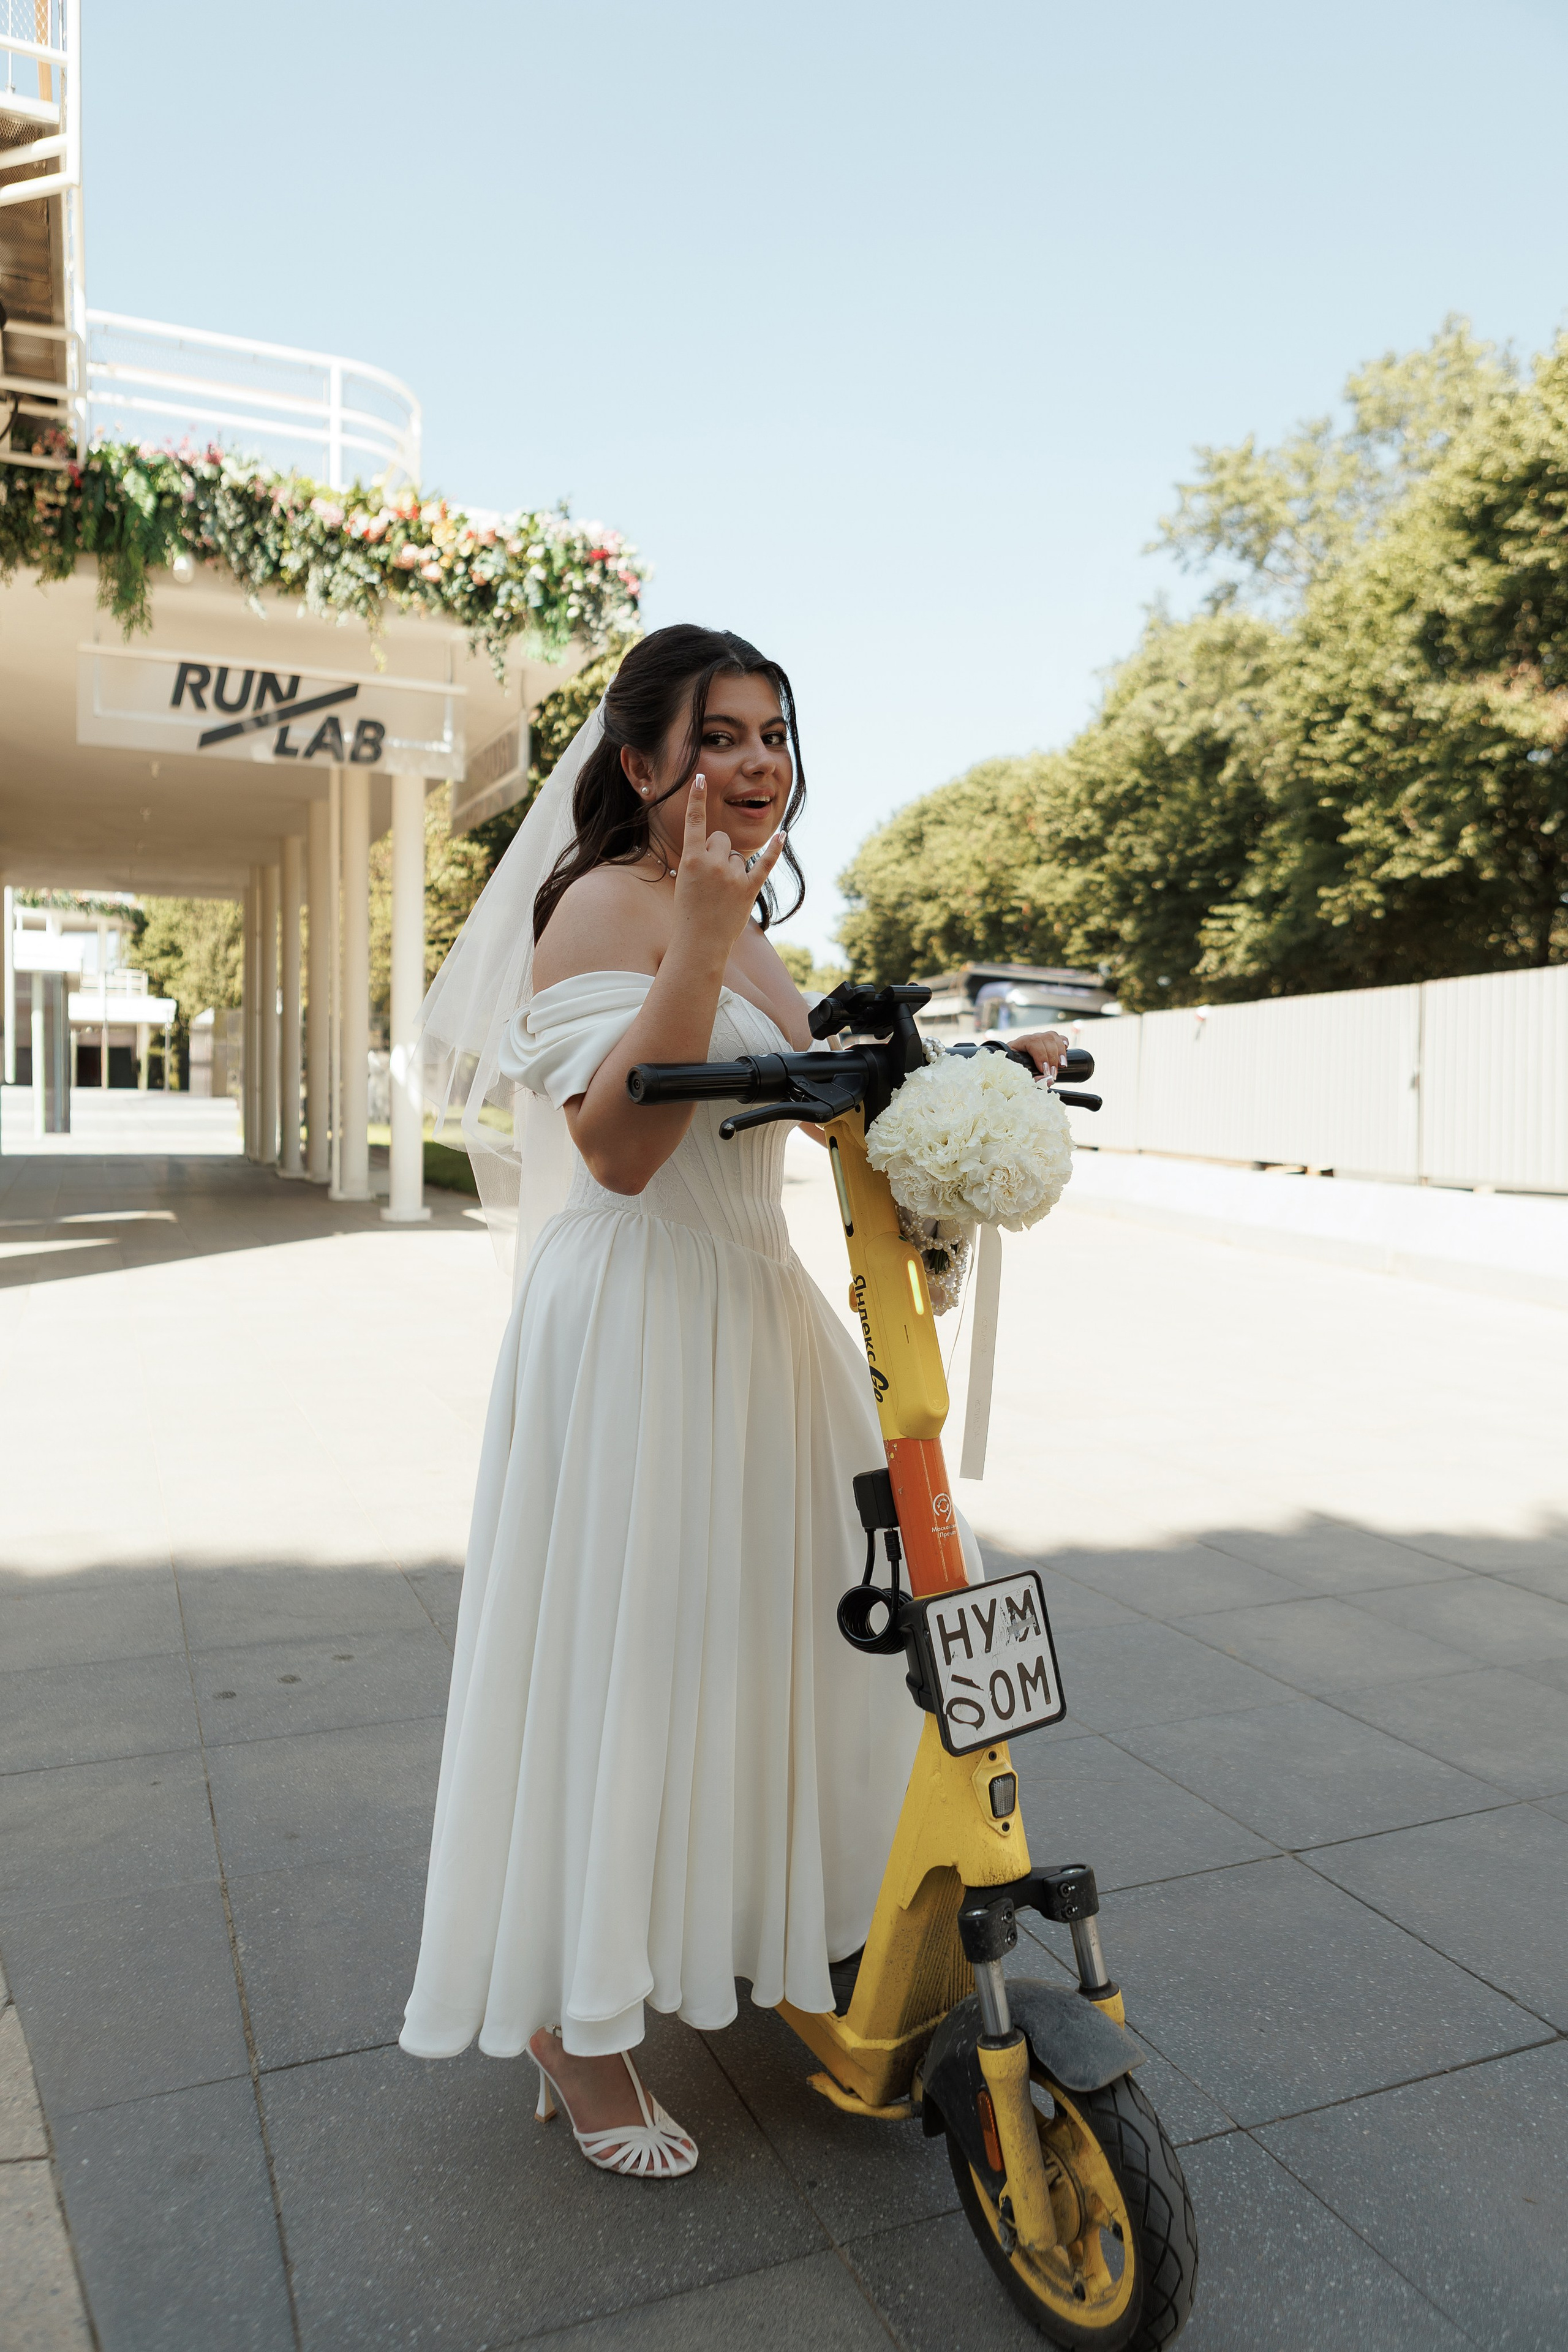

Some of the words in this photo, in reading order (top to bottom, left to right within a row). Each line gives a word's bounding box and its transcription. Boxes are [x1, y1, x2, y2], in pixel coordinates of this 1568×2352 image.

[172, 662, 300, 713] RUN
[274, 716, 385, 764] LAB
[854, 1275, 876, 1363] Яндекс
[869, 1365, 889, 1403] Go
